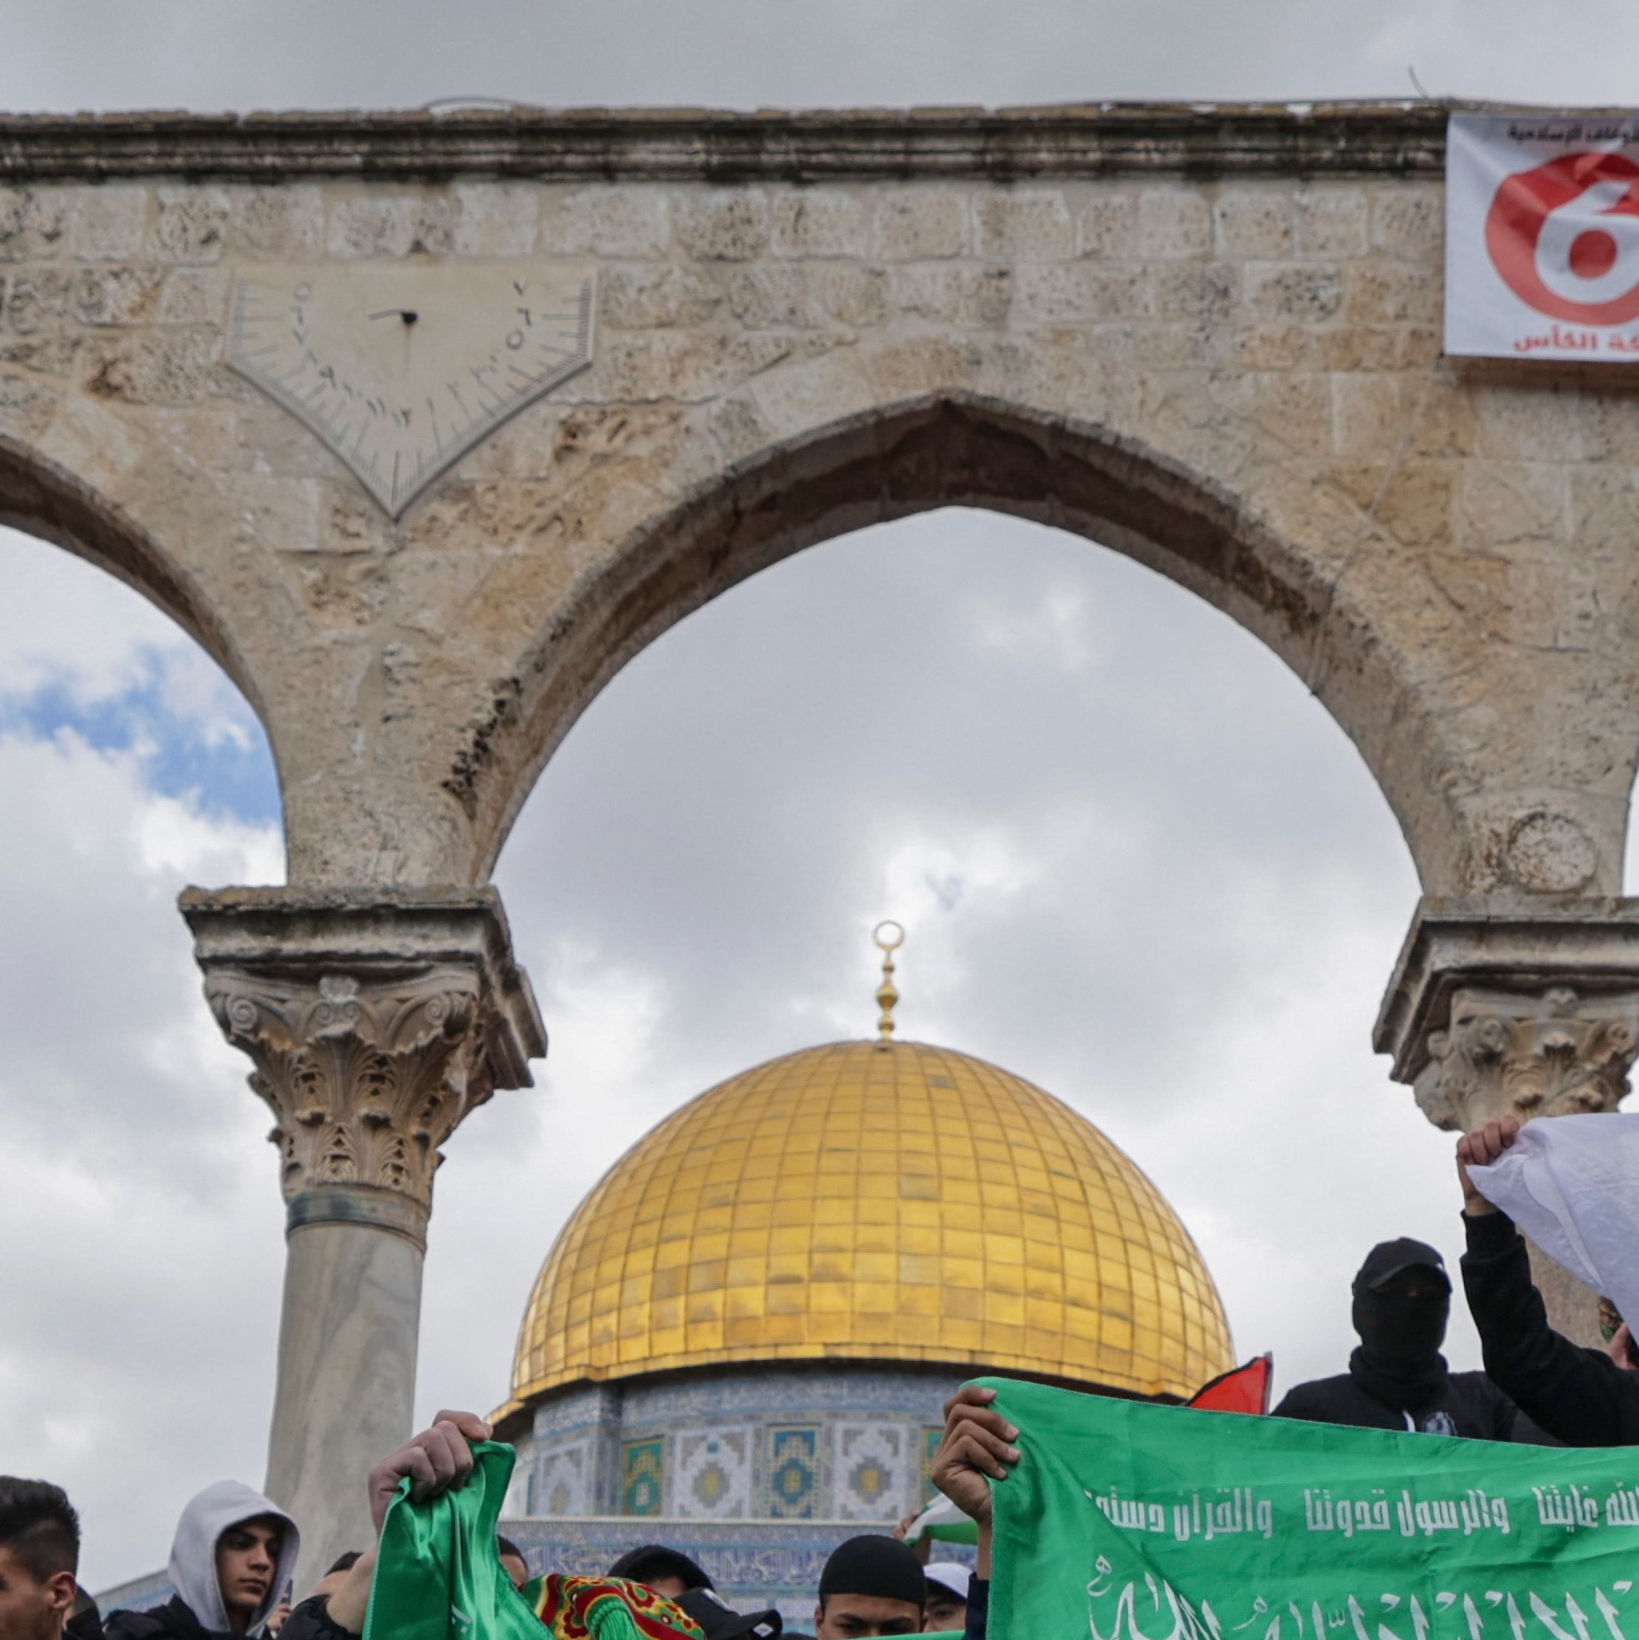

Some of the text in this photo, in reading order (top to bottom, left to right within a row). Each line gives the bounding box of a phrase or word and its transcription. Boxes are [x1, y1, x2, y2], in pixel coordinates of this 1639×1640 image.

[1303, 1488, 1512, 1538] والرسول قدوتنا
[1530, 1483, 1599, 1534] غايتنا
